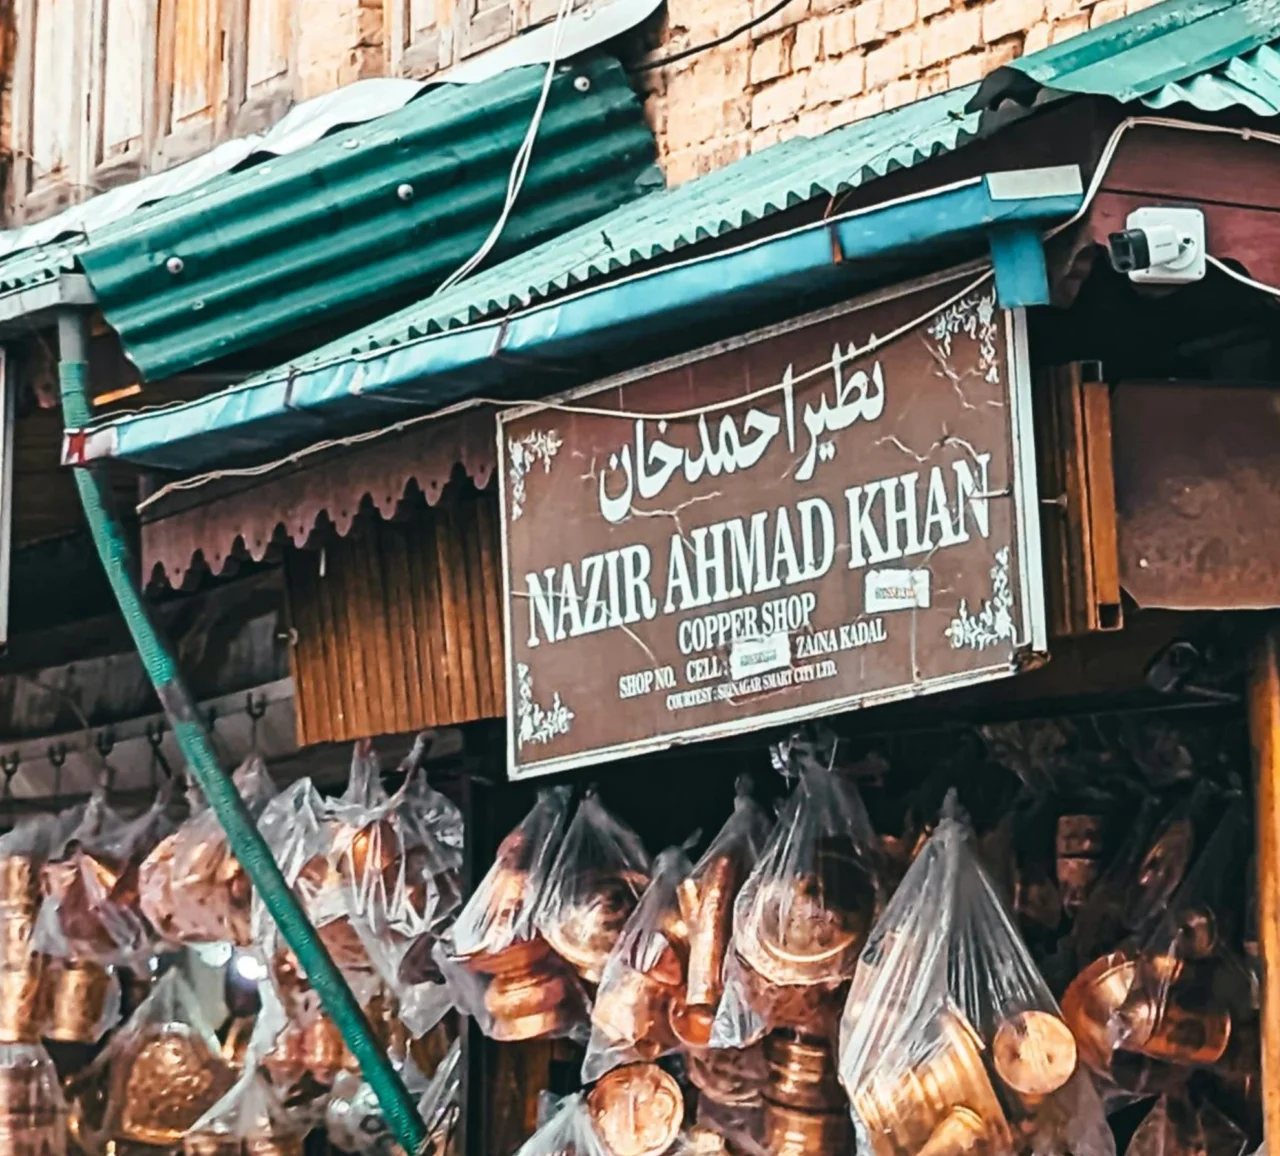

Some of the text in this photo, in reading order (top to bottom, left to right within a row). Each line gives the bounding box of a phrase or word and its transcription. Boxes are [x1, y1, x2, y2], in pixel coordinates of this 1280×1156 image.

[525, 453, 991, 648] NAZIR AHMAD KHAN
[619, 670, 654, 699] SHOP
[839, 618, 887, 650] KADAL
[678, 592, 816, 655] COPPER SHOP
[762, 669, 792, 693] SMART
[793, 666, 815, 684] CITY
